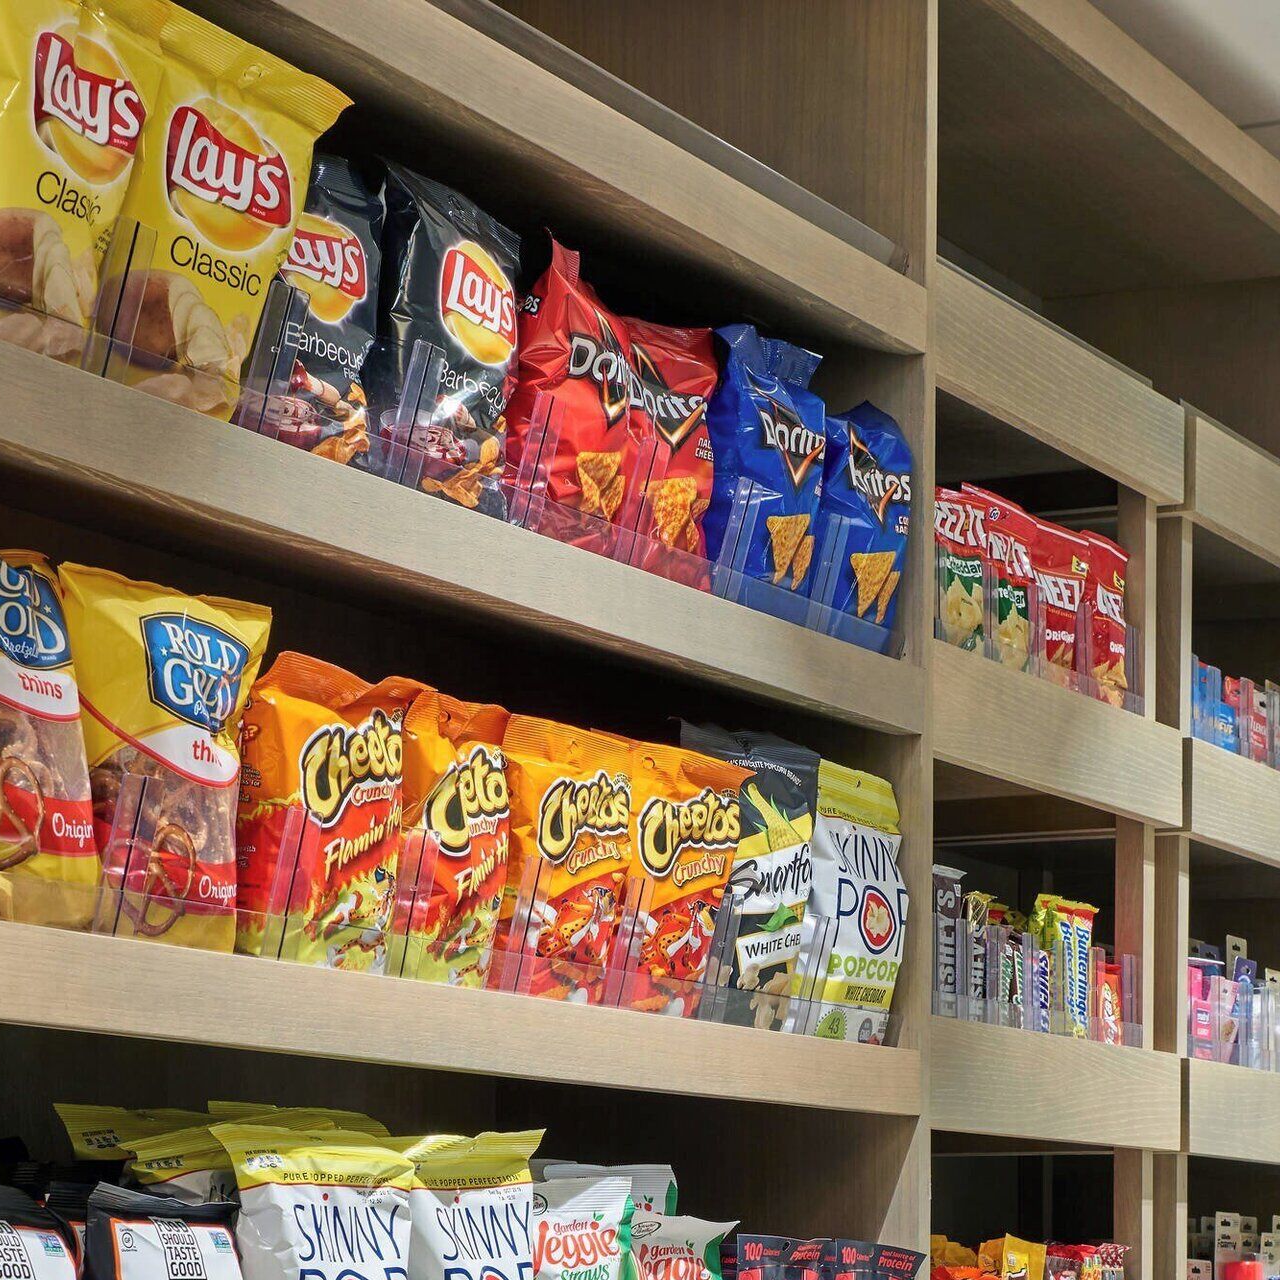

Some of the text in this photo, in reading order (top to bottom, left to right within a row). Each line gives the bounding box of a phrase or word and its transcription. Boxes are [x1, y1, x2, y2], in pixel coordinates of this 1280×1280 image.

[42, 37, 142, 146] Lay's
[170, 110, 285, 212] Lay's
[170, 236, 262, 297] Classic
[446, 253, 515, 334] Lay's
[161, 621, 240, 675] ROLD
[18, 673, 62, 699] thins
[642, 791, 740, 874] Cheetos
[673, 854, 724, 885] Crunchy
[745, 938, 782, 958] WHITE
[828, 1017, 840, 1034] 43
[283, 1172, 308, 1181] PURE
[440, 1174, 520, 1186] POPPED PERFECTION
[293, 1193, 401, 1263] SKINNY
[436, 1195, 532, 1260] SKINNY
[553, 1221, 588, 1234] garden
[162, 1234, 195, 1244] SHOULD
[167, 1246, 200, 1260] TASTE
[651, 1243, 685, 1258] garden
[745, 1243, 763, 1260] 100
[842, 1248, 856, 1264] 100
[170, 1262, 202, 1276] GOOD
[878, 1257, 913, 1271] Protein
